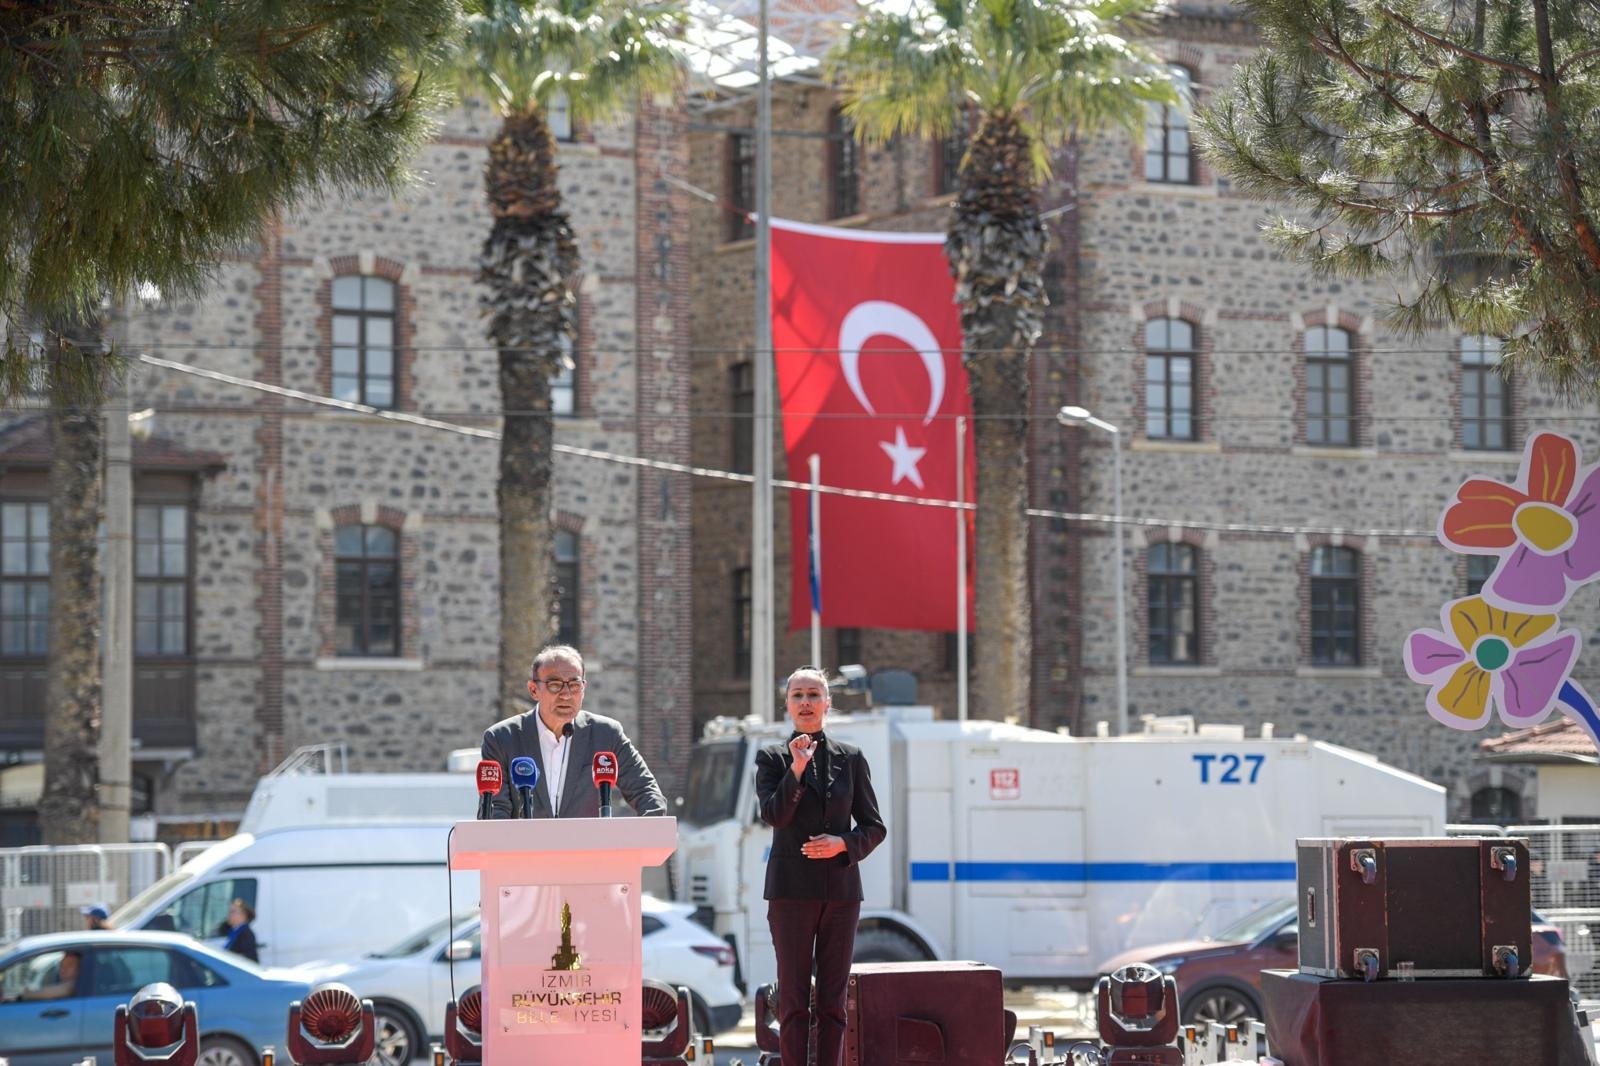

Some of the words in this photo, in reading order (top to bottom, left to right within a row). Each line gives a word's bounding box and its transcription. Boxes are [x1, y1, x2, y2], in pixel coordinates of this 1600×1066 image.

[1192, 754, 1265, 784] T27
[511, 988, 622, 1008] BÜYÜKŞEHİR
[517, 1007, 617, 1024] BELEİYESİ
